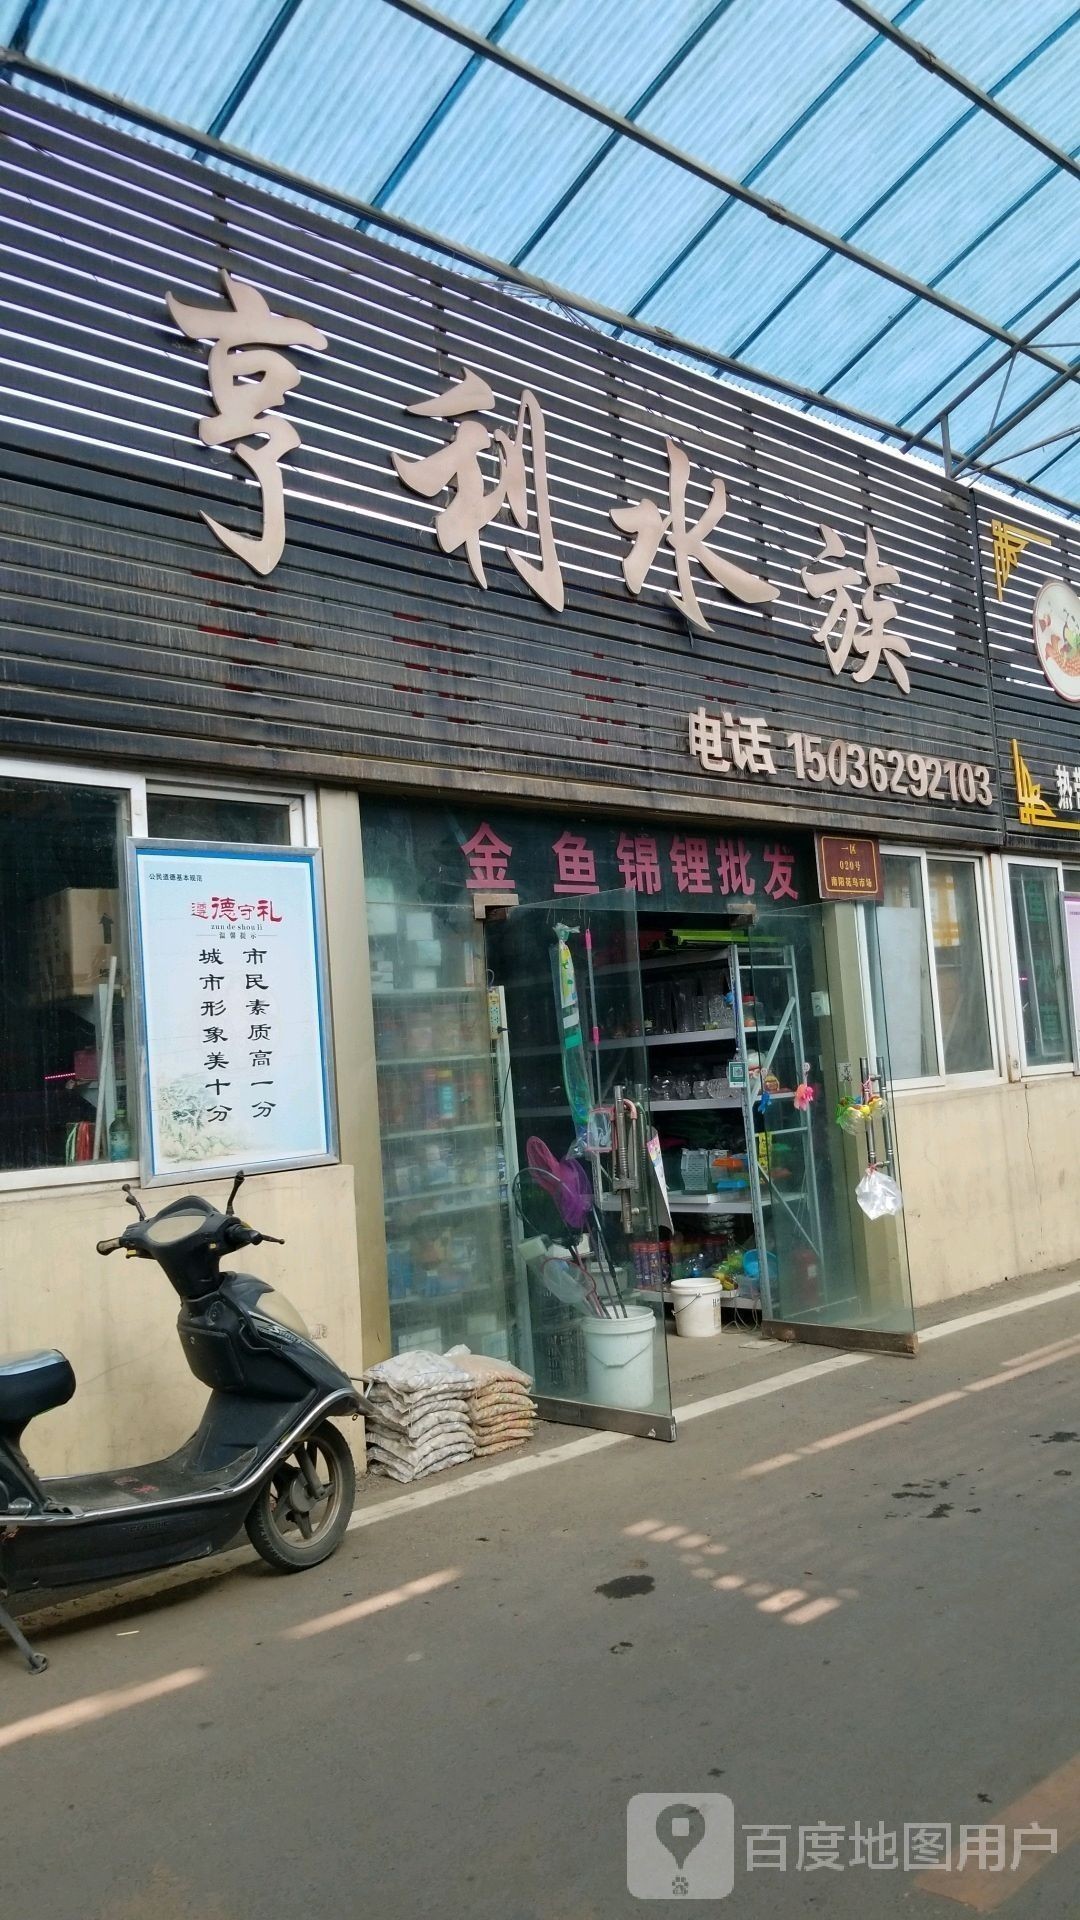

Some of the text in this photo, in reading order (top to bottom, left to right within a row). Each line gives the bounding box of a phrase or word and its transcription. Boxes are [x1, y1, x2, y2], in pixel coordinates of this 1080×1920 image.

[688, 706, 993, 807] 电话 15036292103
[840, 843, 857, 855] 一区
[839, 860, 861, 871] 020号
[148, 873, 203, 882] 公民道德基本规范
[831, 876, 873, 888] 南阳花鸟市场
[191, 896, 283, 922] 遵德守礼
[237, 923, 255, 931] shou
[198, 947, 233, 1123] 城市形象美十分
[242, 947, 277, 1119] 市民素质高一分
